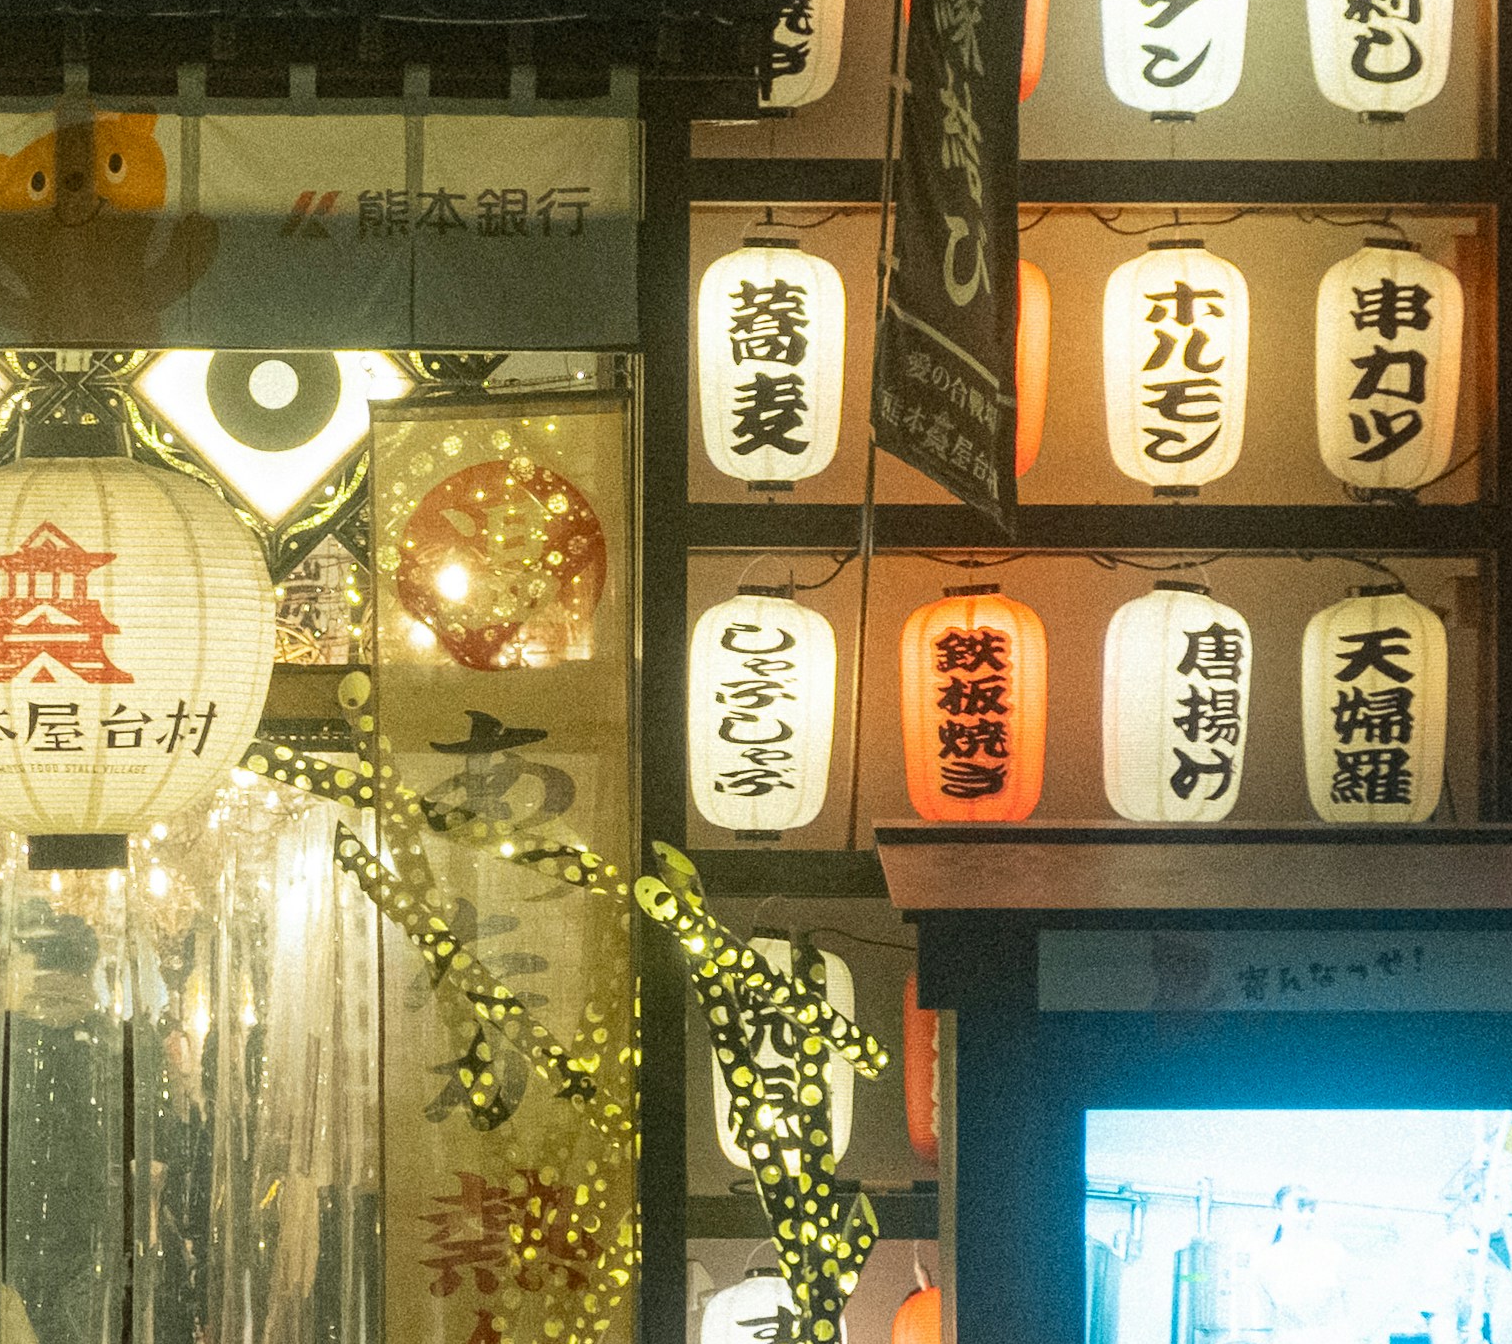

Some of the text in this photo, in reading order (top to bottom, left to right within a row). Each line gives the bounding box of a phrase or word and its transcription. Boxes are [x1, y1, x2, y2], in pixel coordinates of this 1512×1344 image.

[356, 185, 591, 239] 熊本銀行
[728, 278, 812, 457] 蕎麦
[1142, 280, 1227, 465] ホルモン
[1348, 278, 1432, 462] 串カツ
[30, 763, 59, 775] FOOD
[64, 763, 98, 775] STALL
[101, 763, 149, 776] VILLAGE
[713, 621, 796, 798] しゃぶしゃぶ
[934, 627, 1012, 802] 鉄板焼き
[1170, 621, 1246, 803] 唐揚げ
[1330, 626, 1415, 807] 天婦羅
